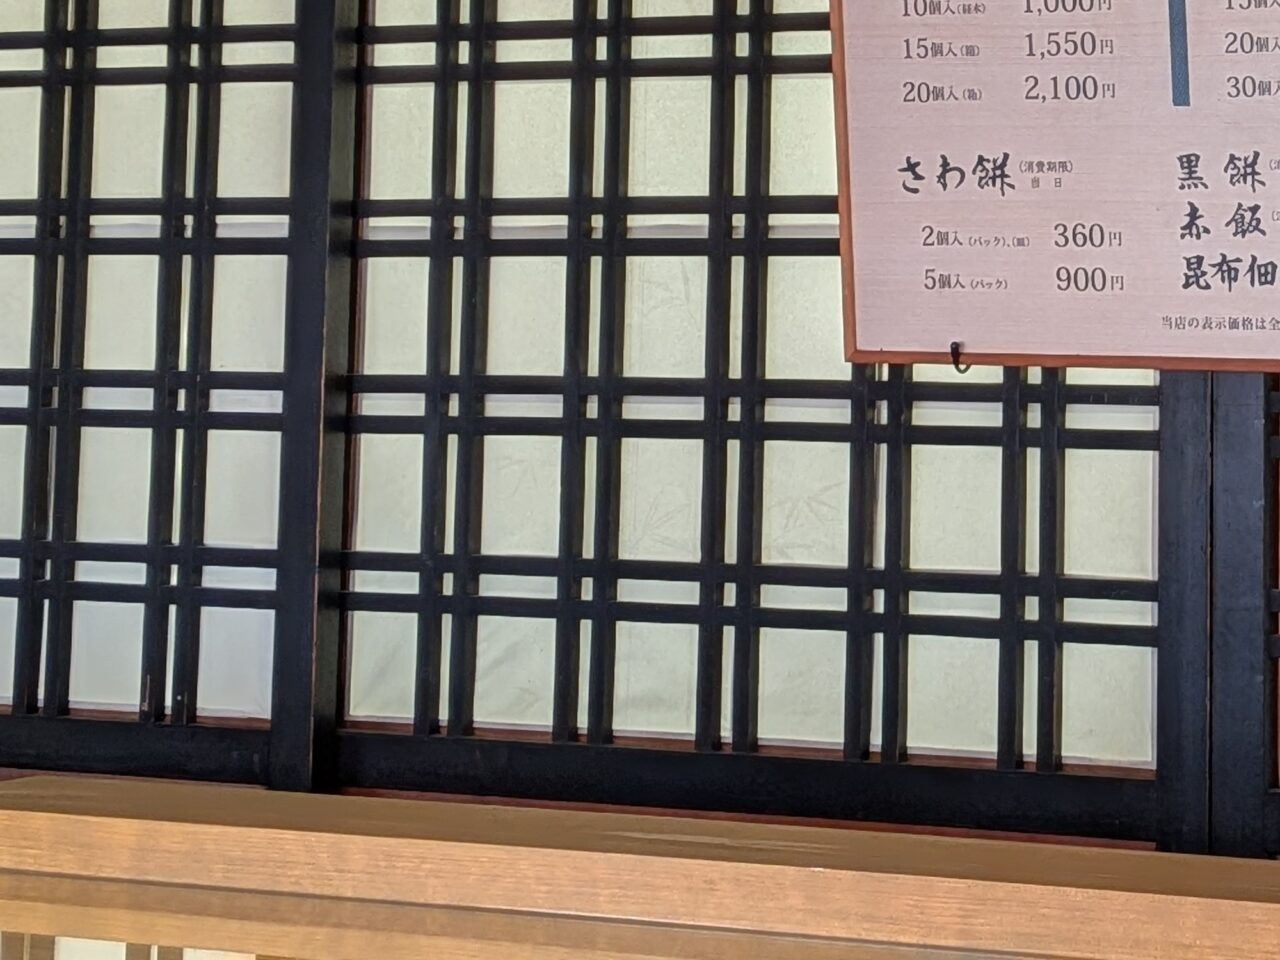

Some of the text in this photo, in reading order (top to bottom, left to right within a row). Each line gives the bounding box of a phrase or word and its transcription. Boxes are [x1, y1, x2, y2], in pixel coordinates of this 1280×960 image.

[1025, 31, 1114, 60] 1,550円
[1025, 76, 1116, 104] 2,100円
[898, 152, 1015, 197] さわ餅
[1054, 223, 1122, 248] 360円
[1056, 267, 1124, 292] 900円
